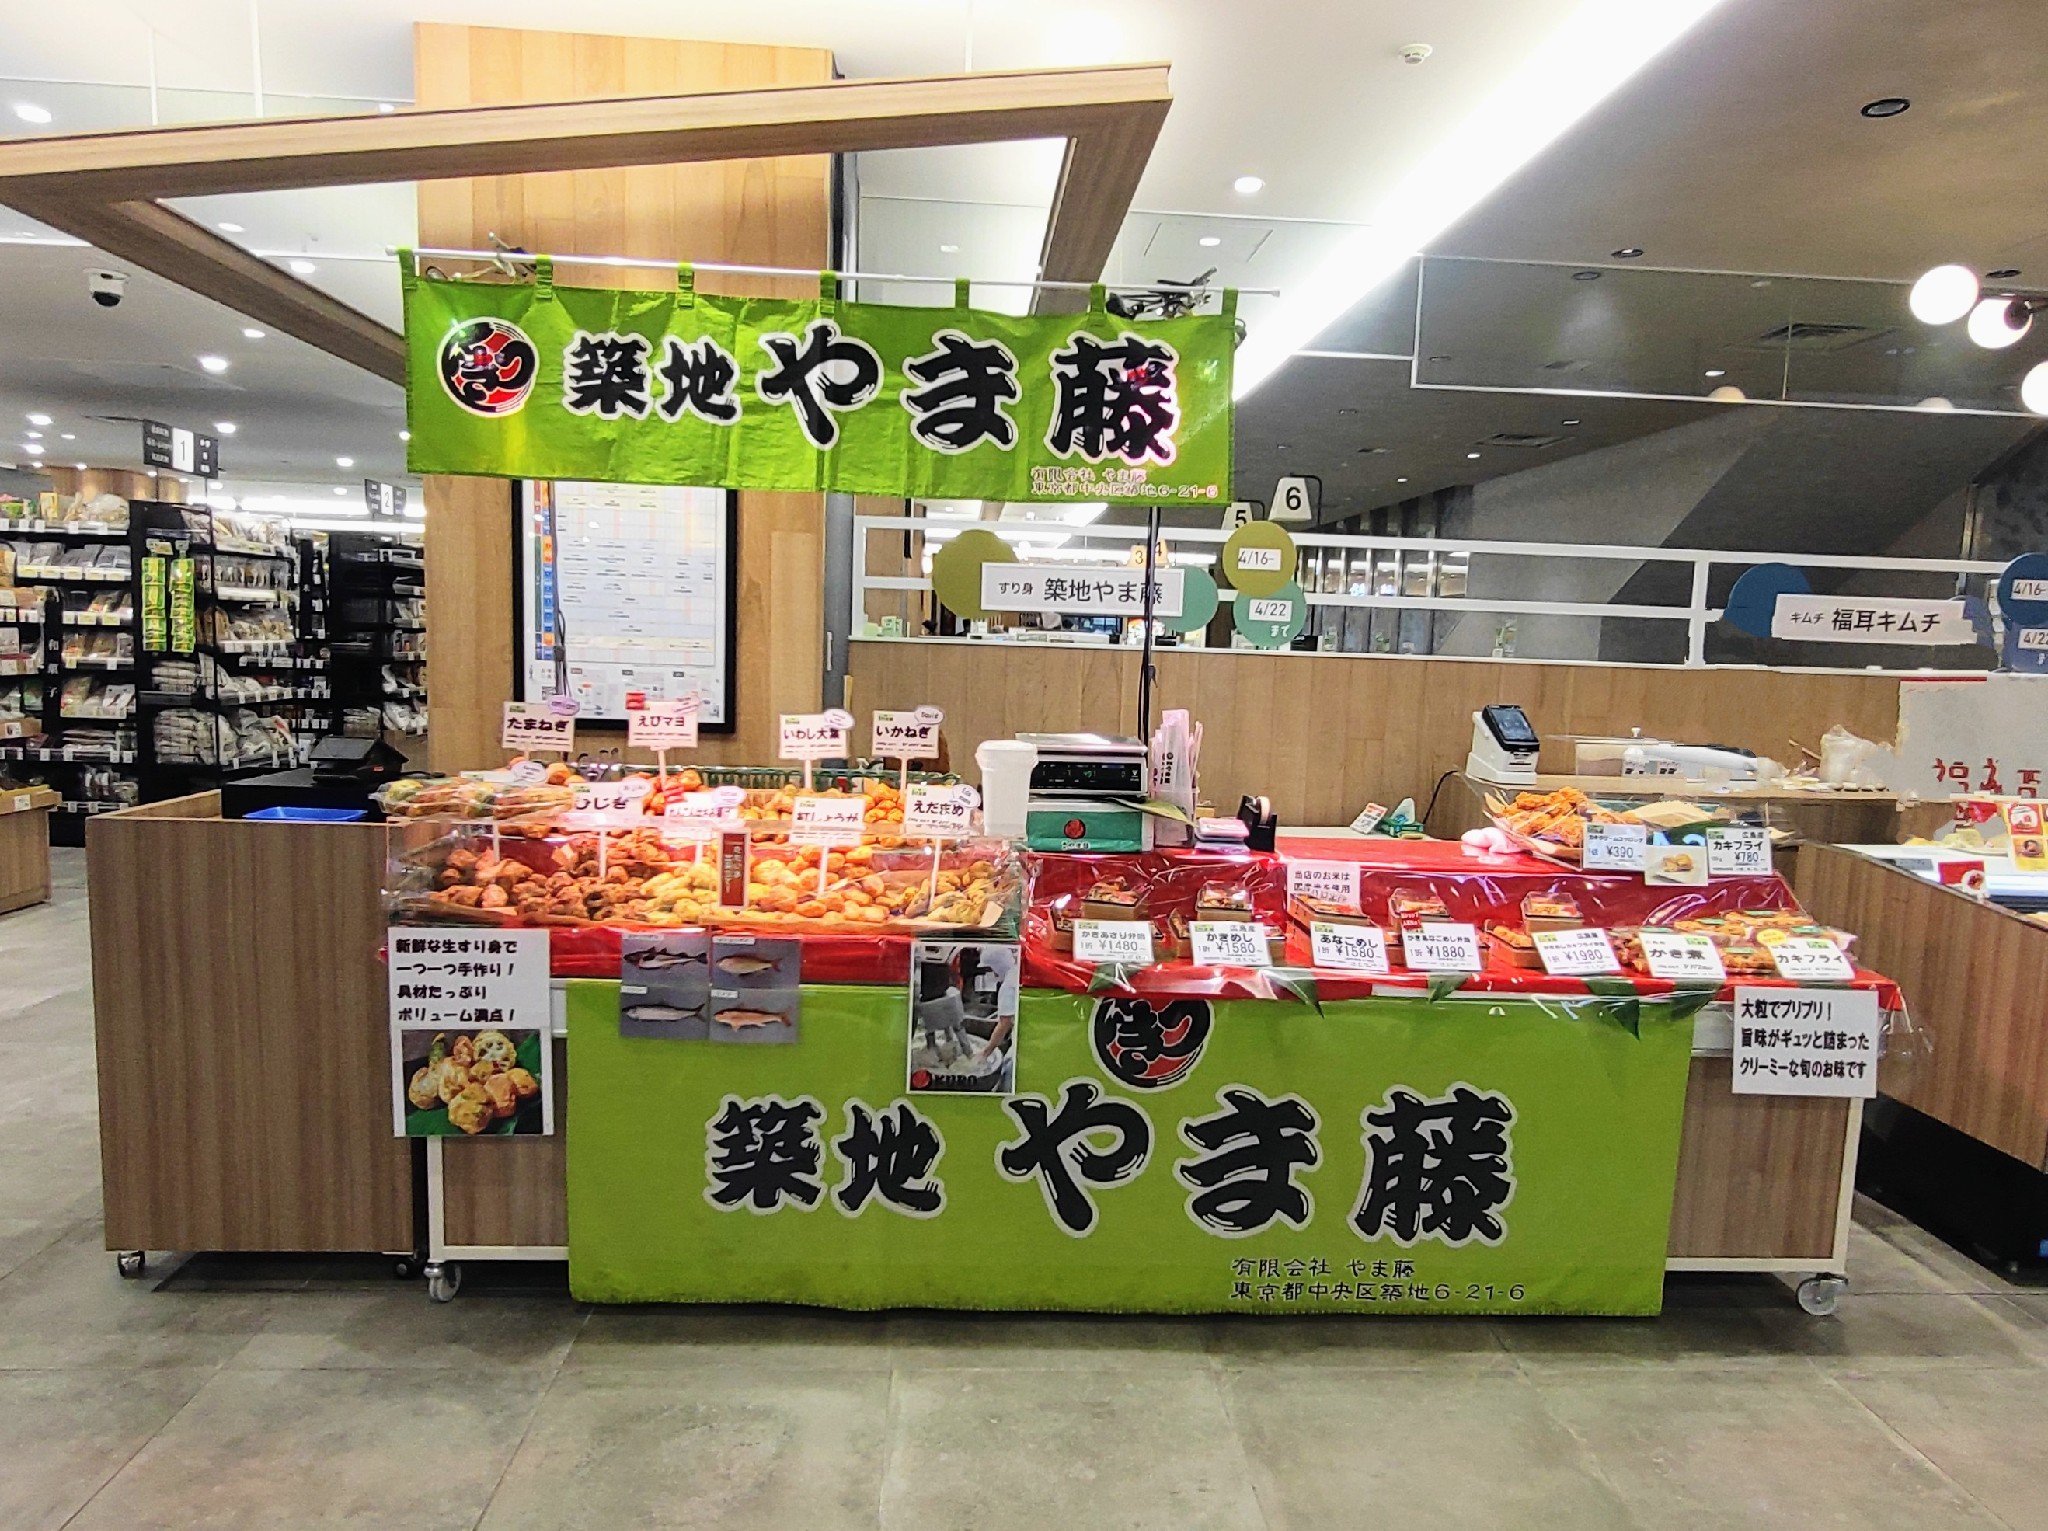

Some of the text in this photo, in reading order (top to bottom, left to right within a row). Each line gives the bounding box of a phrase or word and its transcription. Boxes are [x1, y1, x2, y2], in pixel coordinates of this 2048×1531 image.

[563, 320, 1180, 463] 築地やま藤
[1286, 486, 1302, 511] 6
[1235, 509, 1248, 529] 5
[1135, 550, 1144, 565] 3
[999, 582, 1034, 595] すり身
[1254, 602, 1288, 617] 4/22
[1791, 607, 1942, 633] キムチ 福耳キムチ
[507, 716, 570, 733] たまねぎ
[638, 715, 685, 727] えびマヨ
[876, 725, 932, 739] いかねぎ
[1713, 840, 1764, 851] カキフライ
[1099, 939, 1138, 951] ¥1480
[1206, 932, 1254, 943] かきめし
[395, 938, 518, 954] 新鮮な生すり身で
[1215, 941, 1256, 954] ¥1580
[1336, 944, 1375, 959] ¥1580
[1425, 945, 1466, 958] ¥1880
[1776, 954, 1843, 964] カキフライ
[396, 962, 515, 978] 一つ一つ手作り！
[398, 1007, 515, 1022] ボリューム満点！
[1740, 1027, 1870, 1051] 旨味がギュッと詰まった
[1739, 1057, 1868, 1079] クリーミーな旬のお味です
[705, 1075, 1515, 1246] 築地やま藤
[1231, 1257, 1416, 1279] 有限会社 やま藤
[1230, 1281, 1526, 1301] 東京都中央区築地6-21-6
